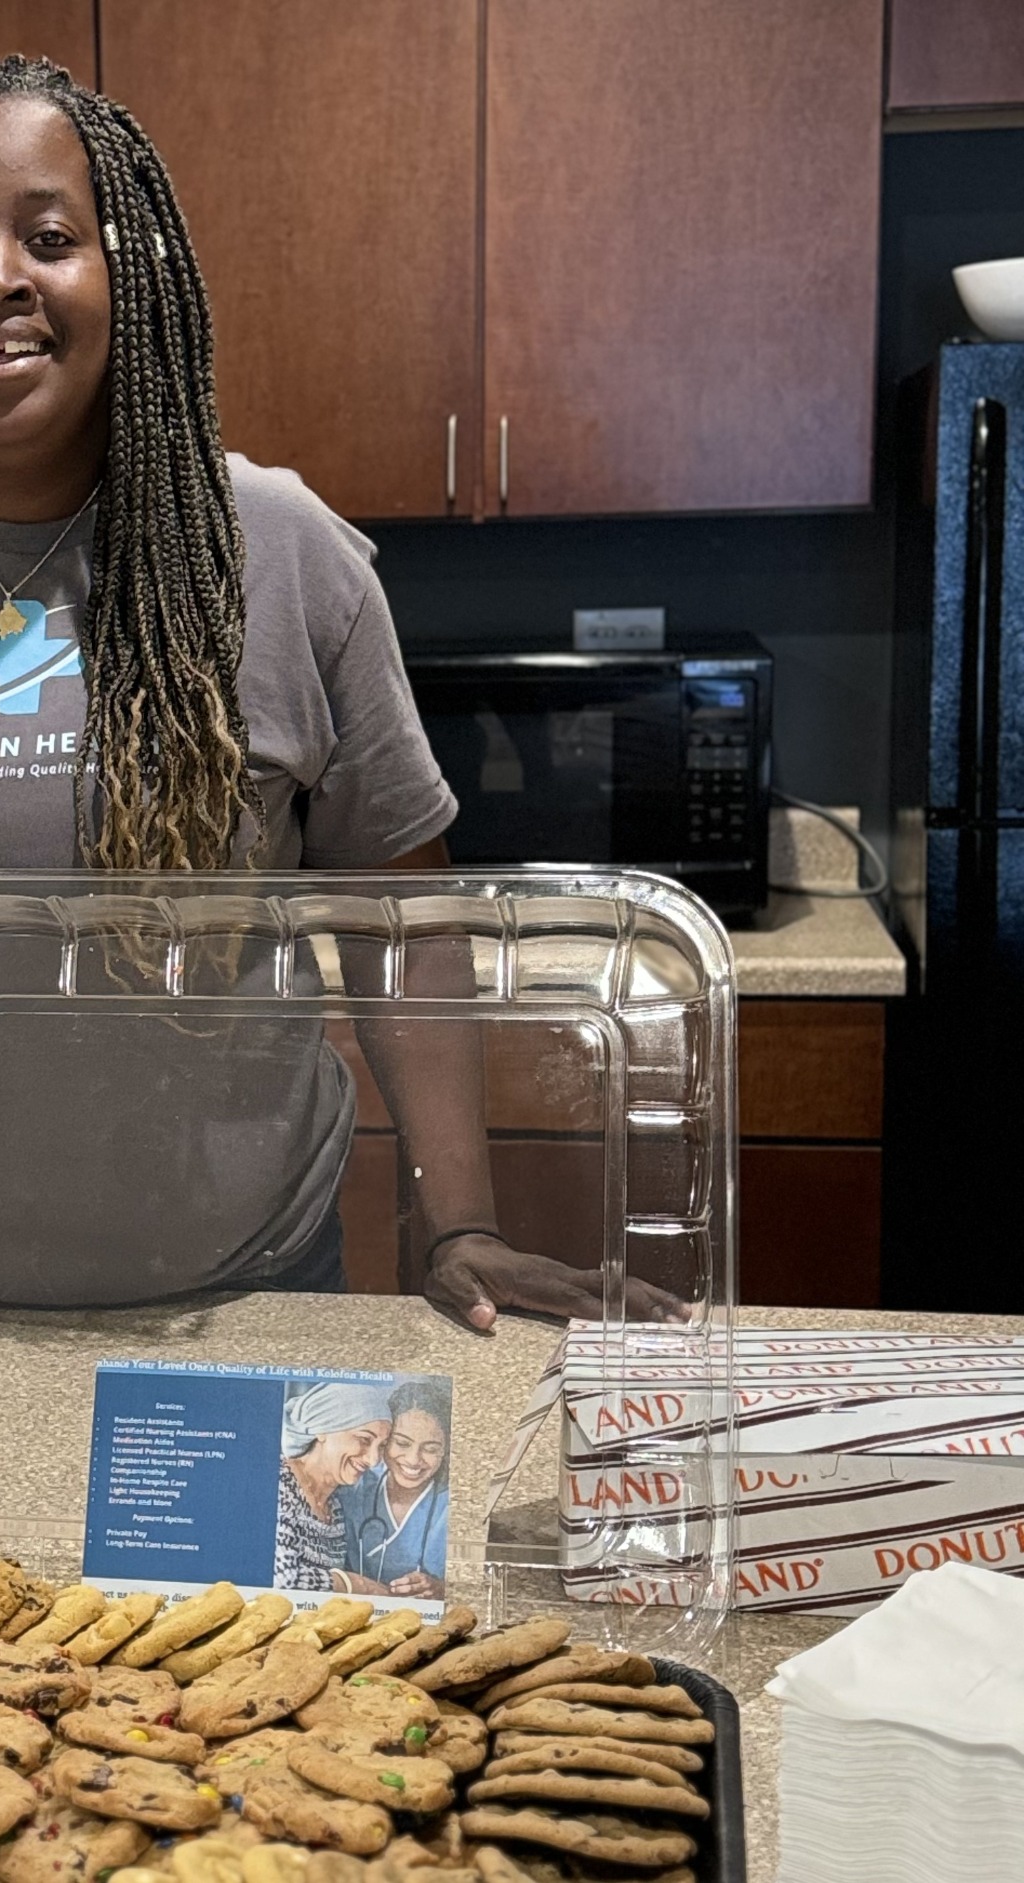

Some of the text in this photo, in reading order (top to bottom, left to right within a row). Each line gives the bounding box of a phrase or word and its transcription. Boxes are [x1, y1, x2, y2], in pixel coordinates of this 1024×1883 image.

[133, 1359, 156, 1370] Your
[157, 1360, 187, 1371] Loved
[188, 1361, 215, 1372] One's
[216, 1363, 254, 1375] Quality
[255, 1364, 268, 1375] of
[269, 1365, 290, 1376] Life
[292, 1367, 314, 1377] with
[317, 1368, 357, 1379] Kolofon
[359, 1370, 394, 1382] Health
